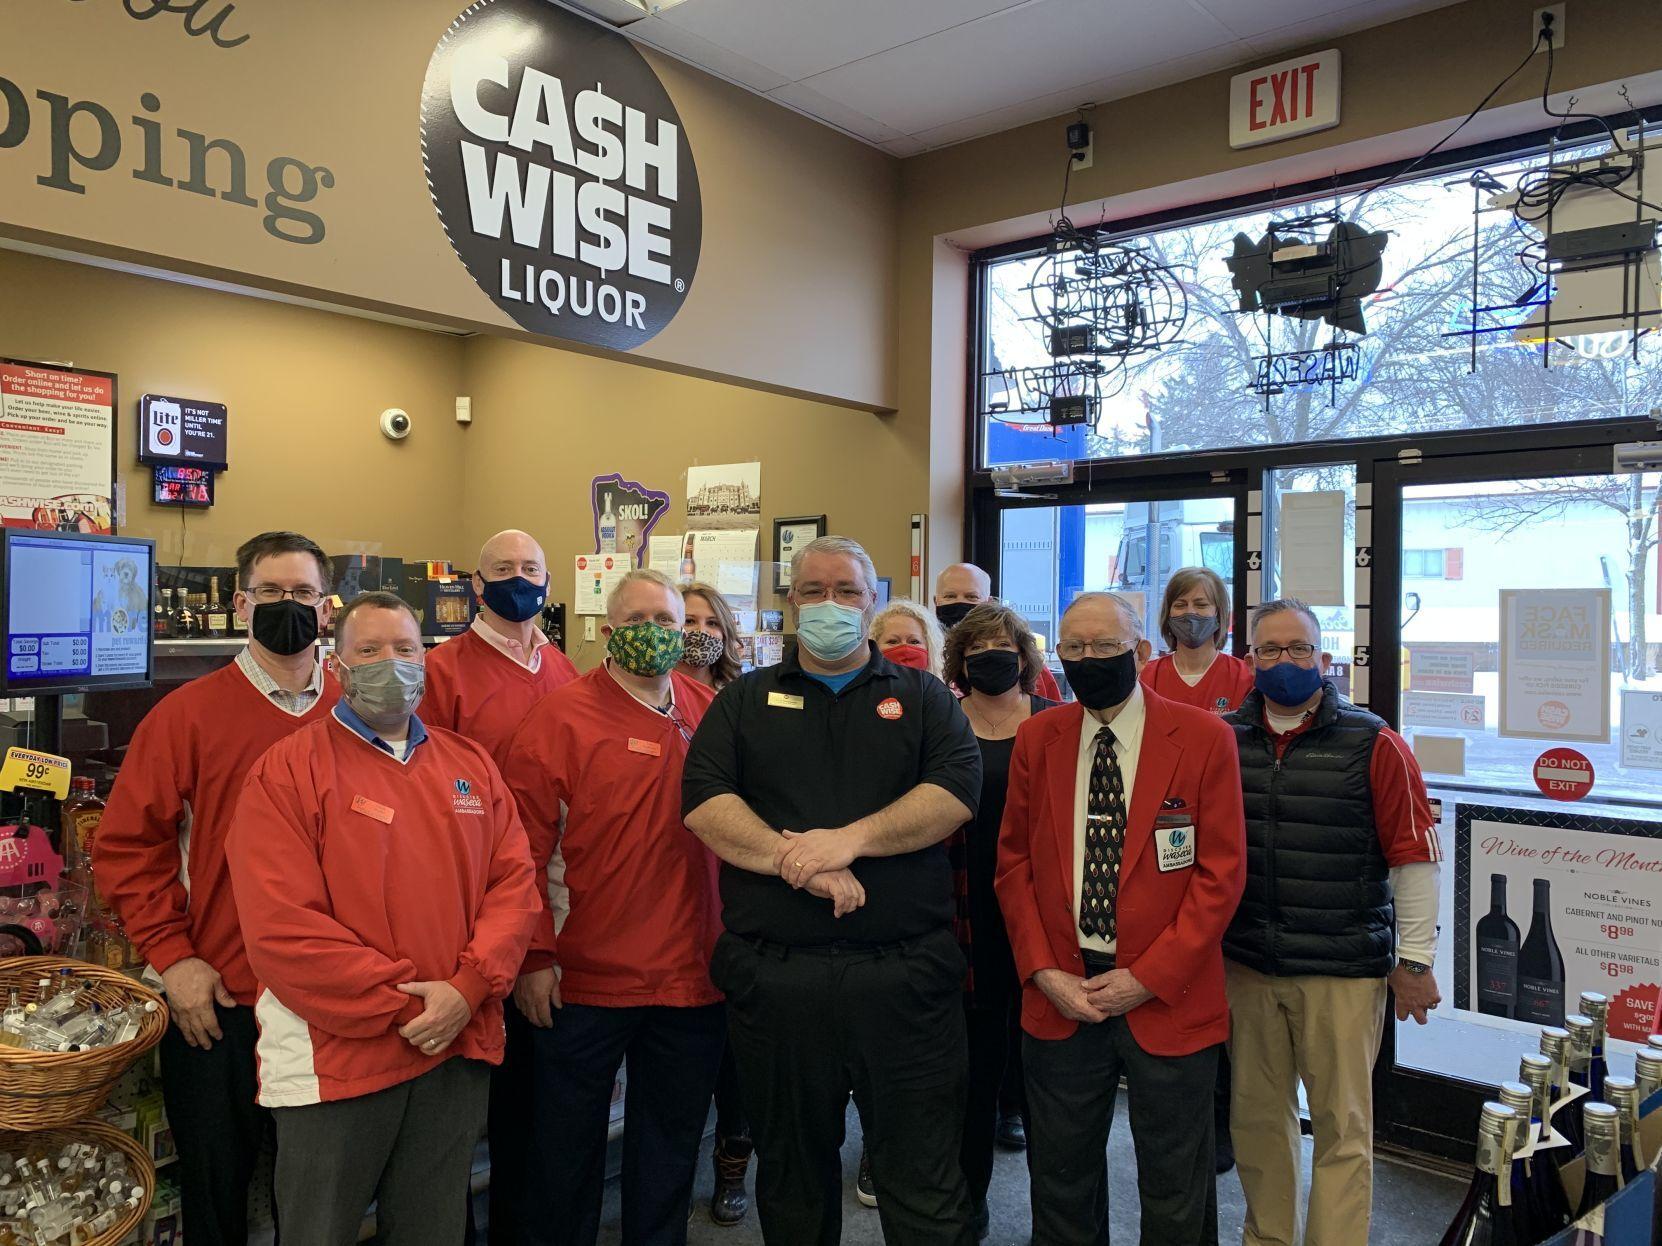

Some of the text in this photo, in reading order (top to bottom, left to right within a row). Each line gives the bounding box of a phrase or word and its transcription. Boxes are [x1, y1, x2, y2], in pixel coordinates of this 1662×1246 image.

[1249, 62, 1320, 132] EXIT
[501, 258, 647, 331] LIQUOR
[25, 369, 47, 379] Short
[61, 374, 83, 384] time?
[2, 374, 26, 384] Order
[28, 379, 52, 388] online
[54, 382, 70, 390] and
[94, 386, 104, 395] do
[27, 385, 65, 398] shopping
[153, 410, 179, 427] Lite
[184, 415, 207, 423] MILLER
[184, 422, 202, 430] UNTIL
[618, 504, 648, 520] SKOL!
[1247, 552, 1261, 570] 6
[1355, 547, 1371, 567] 6
[19, 644, 36, 652] $0.00
[72, 638, 87, 646] $0.00
[72, 648, 87, 656] $0.00
[1354, 646, 1369, 666] 5
[72, 658, 87, 666] $0.00
[11, 751, 41, 762] EVERYDAY
[1540, 757, 1589, 770] DO NOT
[1549, 780, 1578, 792] EXIT
[1480, 836, 1539, 858] Wine
[1541, 846, 1562, 864] of
[1562, 849, 1592, 864] the
[1584, 892, 1652, 908] NOBLE VINES
[1565, 907, 1605, 919] CABERNET
[1606, 912, 1624, 922] AND
[1625, 915, 1649, 926] PINOT
[1481, 946, 1498, 954] NOBLE
[1575, 946, 1660, 967] ALL OTHER VARIETALS
[1523, 983, 1542, 992] NOBLE
[1626, 997, 1655, 1012] SAVE
[1623, 1022, 1641, 1031] WITH
